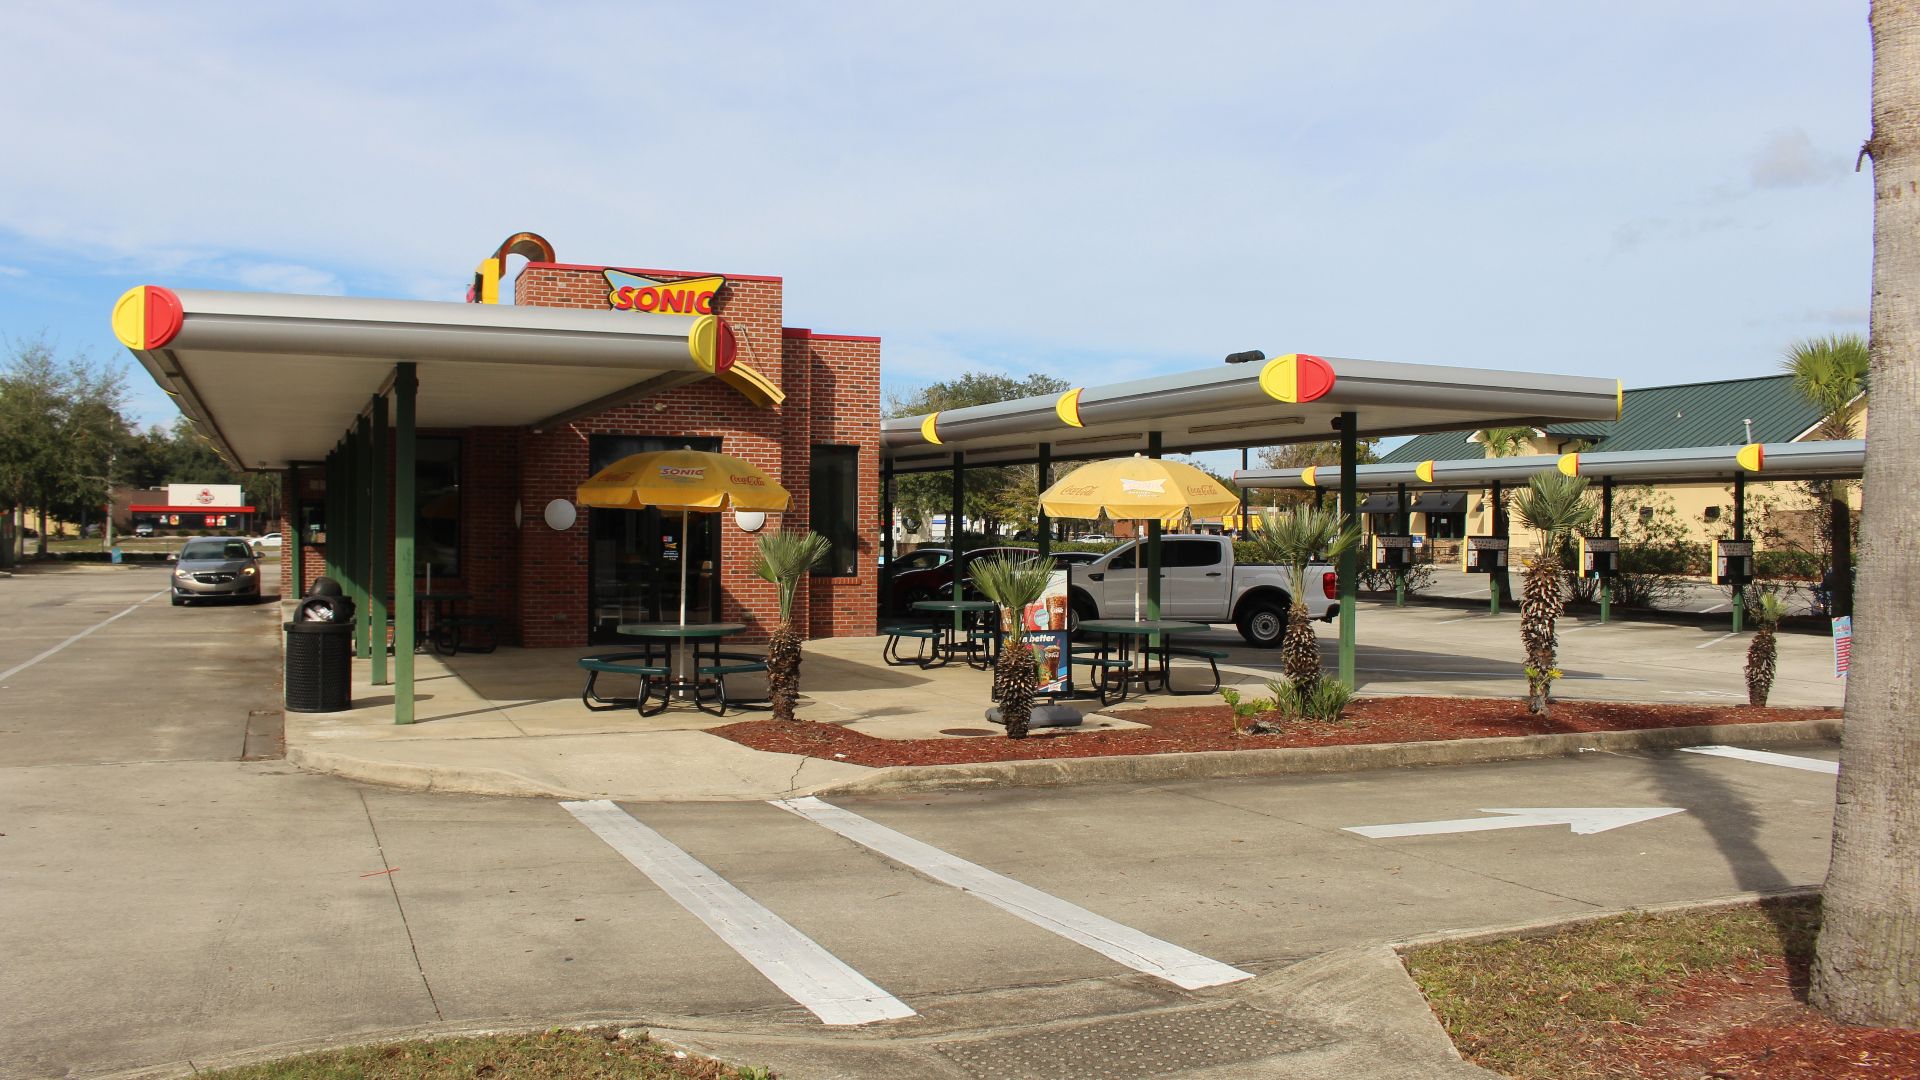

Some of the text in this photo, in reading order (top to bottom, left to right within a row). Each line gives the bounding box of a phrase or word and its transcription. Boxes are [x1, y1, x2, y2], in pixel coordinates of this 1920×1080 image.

[614, 286, 714, 314] SONIC
[661, 468, 704, 476] SONIC
[1028, 634, 1056, 643] better
